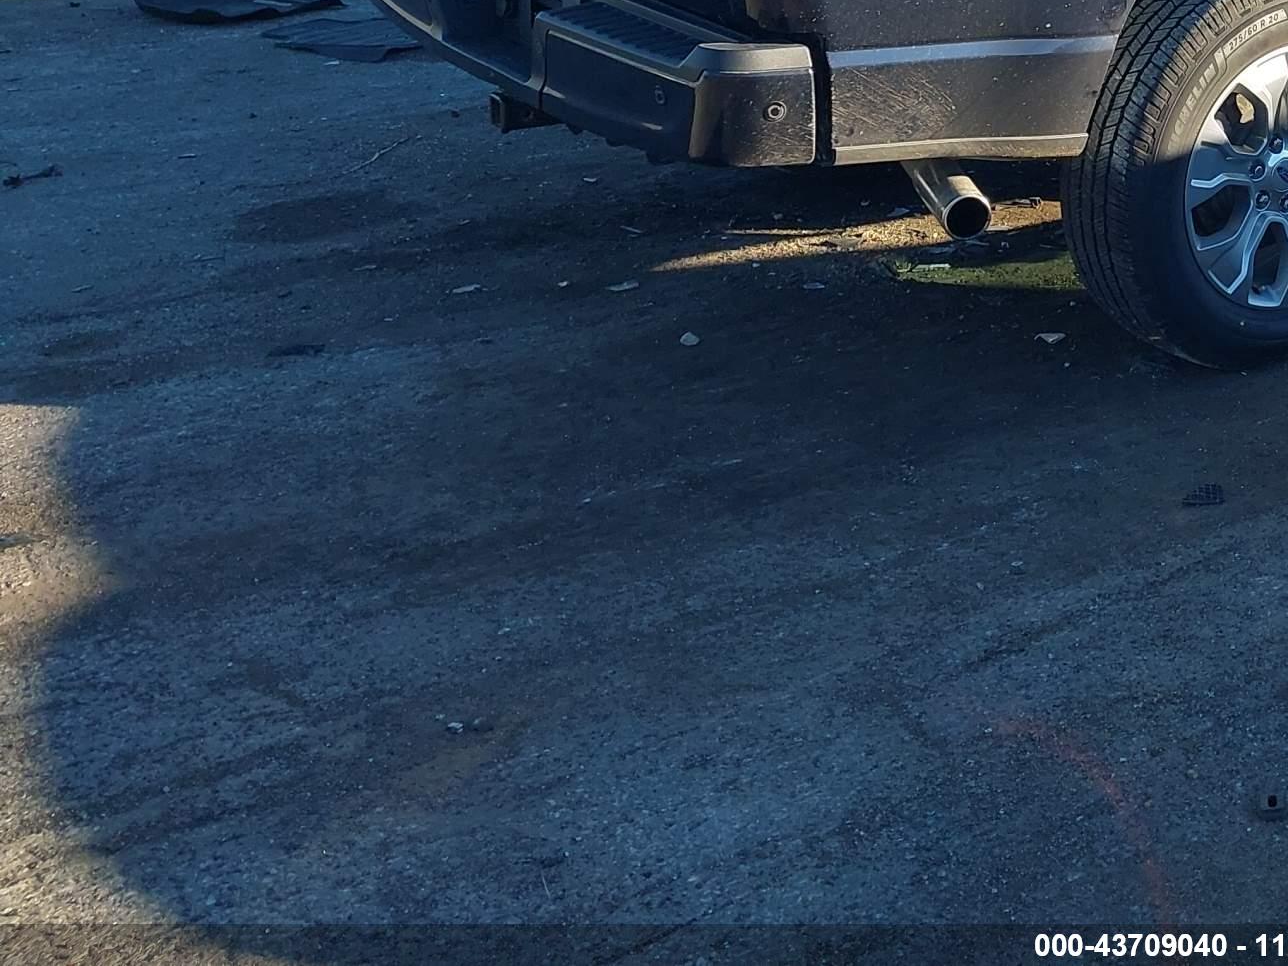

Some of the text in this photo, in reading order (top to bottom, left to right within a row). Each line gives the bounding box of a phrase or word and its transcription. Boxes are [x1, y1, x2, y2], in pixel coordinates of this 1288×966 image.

[1228, 13, 1279, 51] 275/60 R 20
